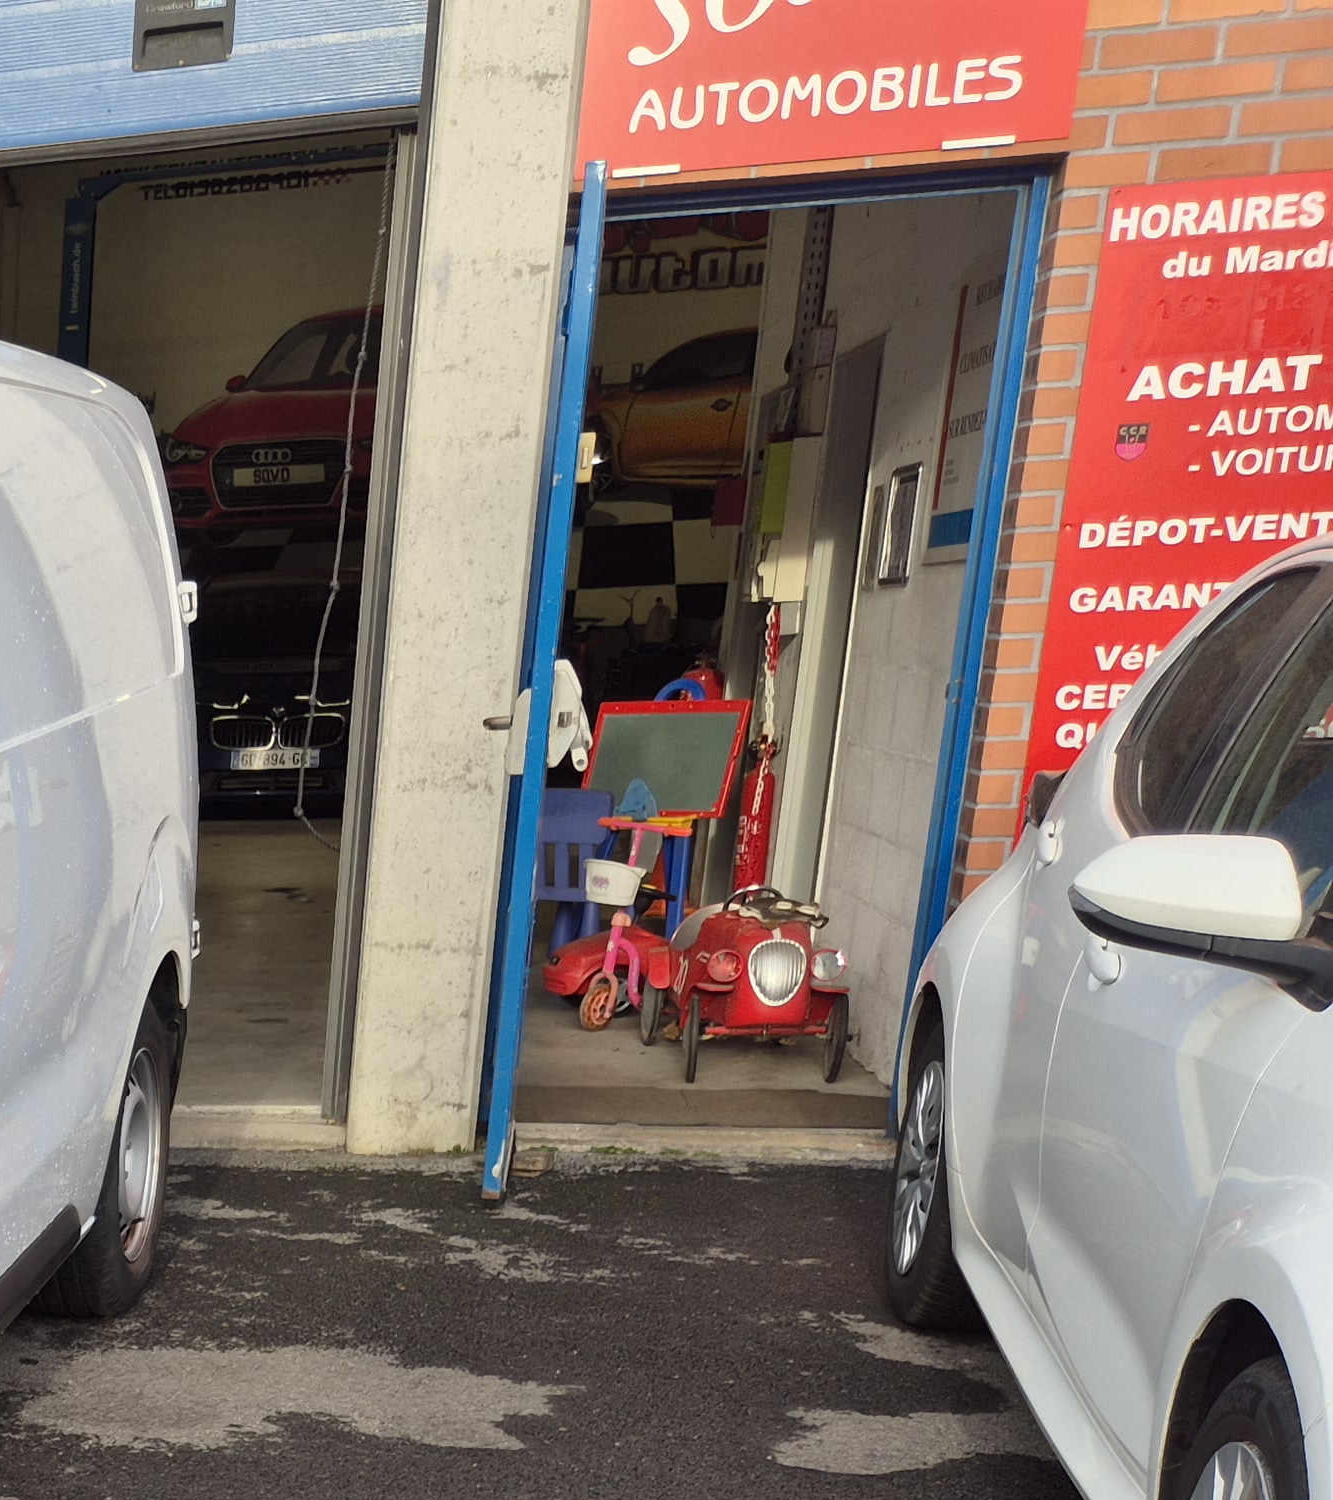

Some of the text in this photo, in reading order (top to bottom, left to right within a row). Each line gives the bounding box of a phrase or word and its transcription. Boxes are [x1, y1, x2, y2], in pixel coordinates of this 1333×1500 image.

[629, 55, 1023, 134] AUTOMOBILES
[1109, 191, 1327, 241] HORAIRES
[1162, 251, 1212, 278] du
[1126, 354, 1324, 401] ACHAT
